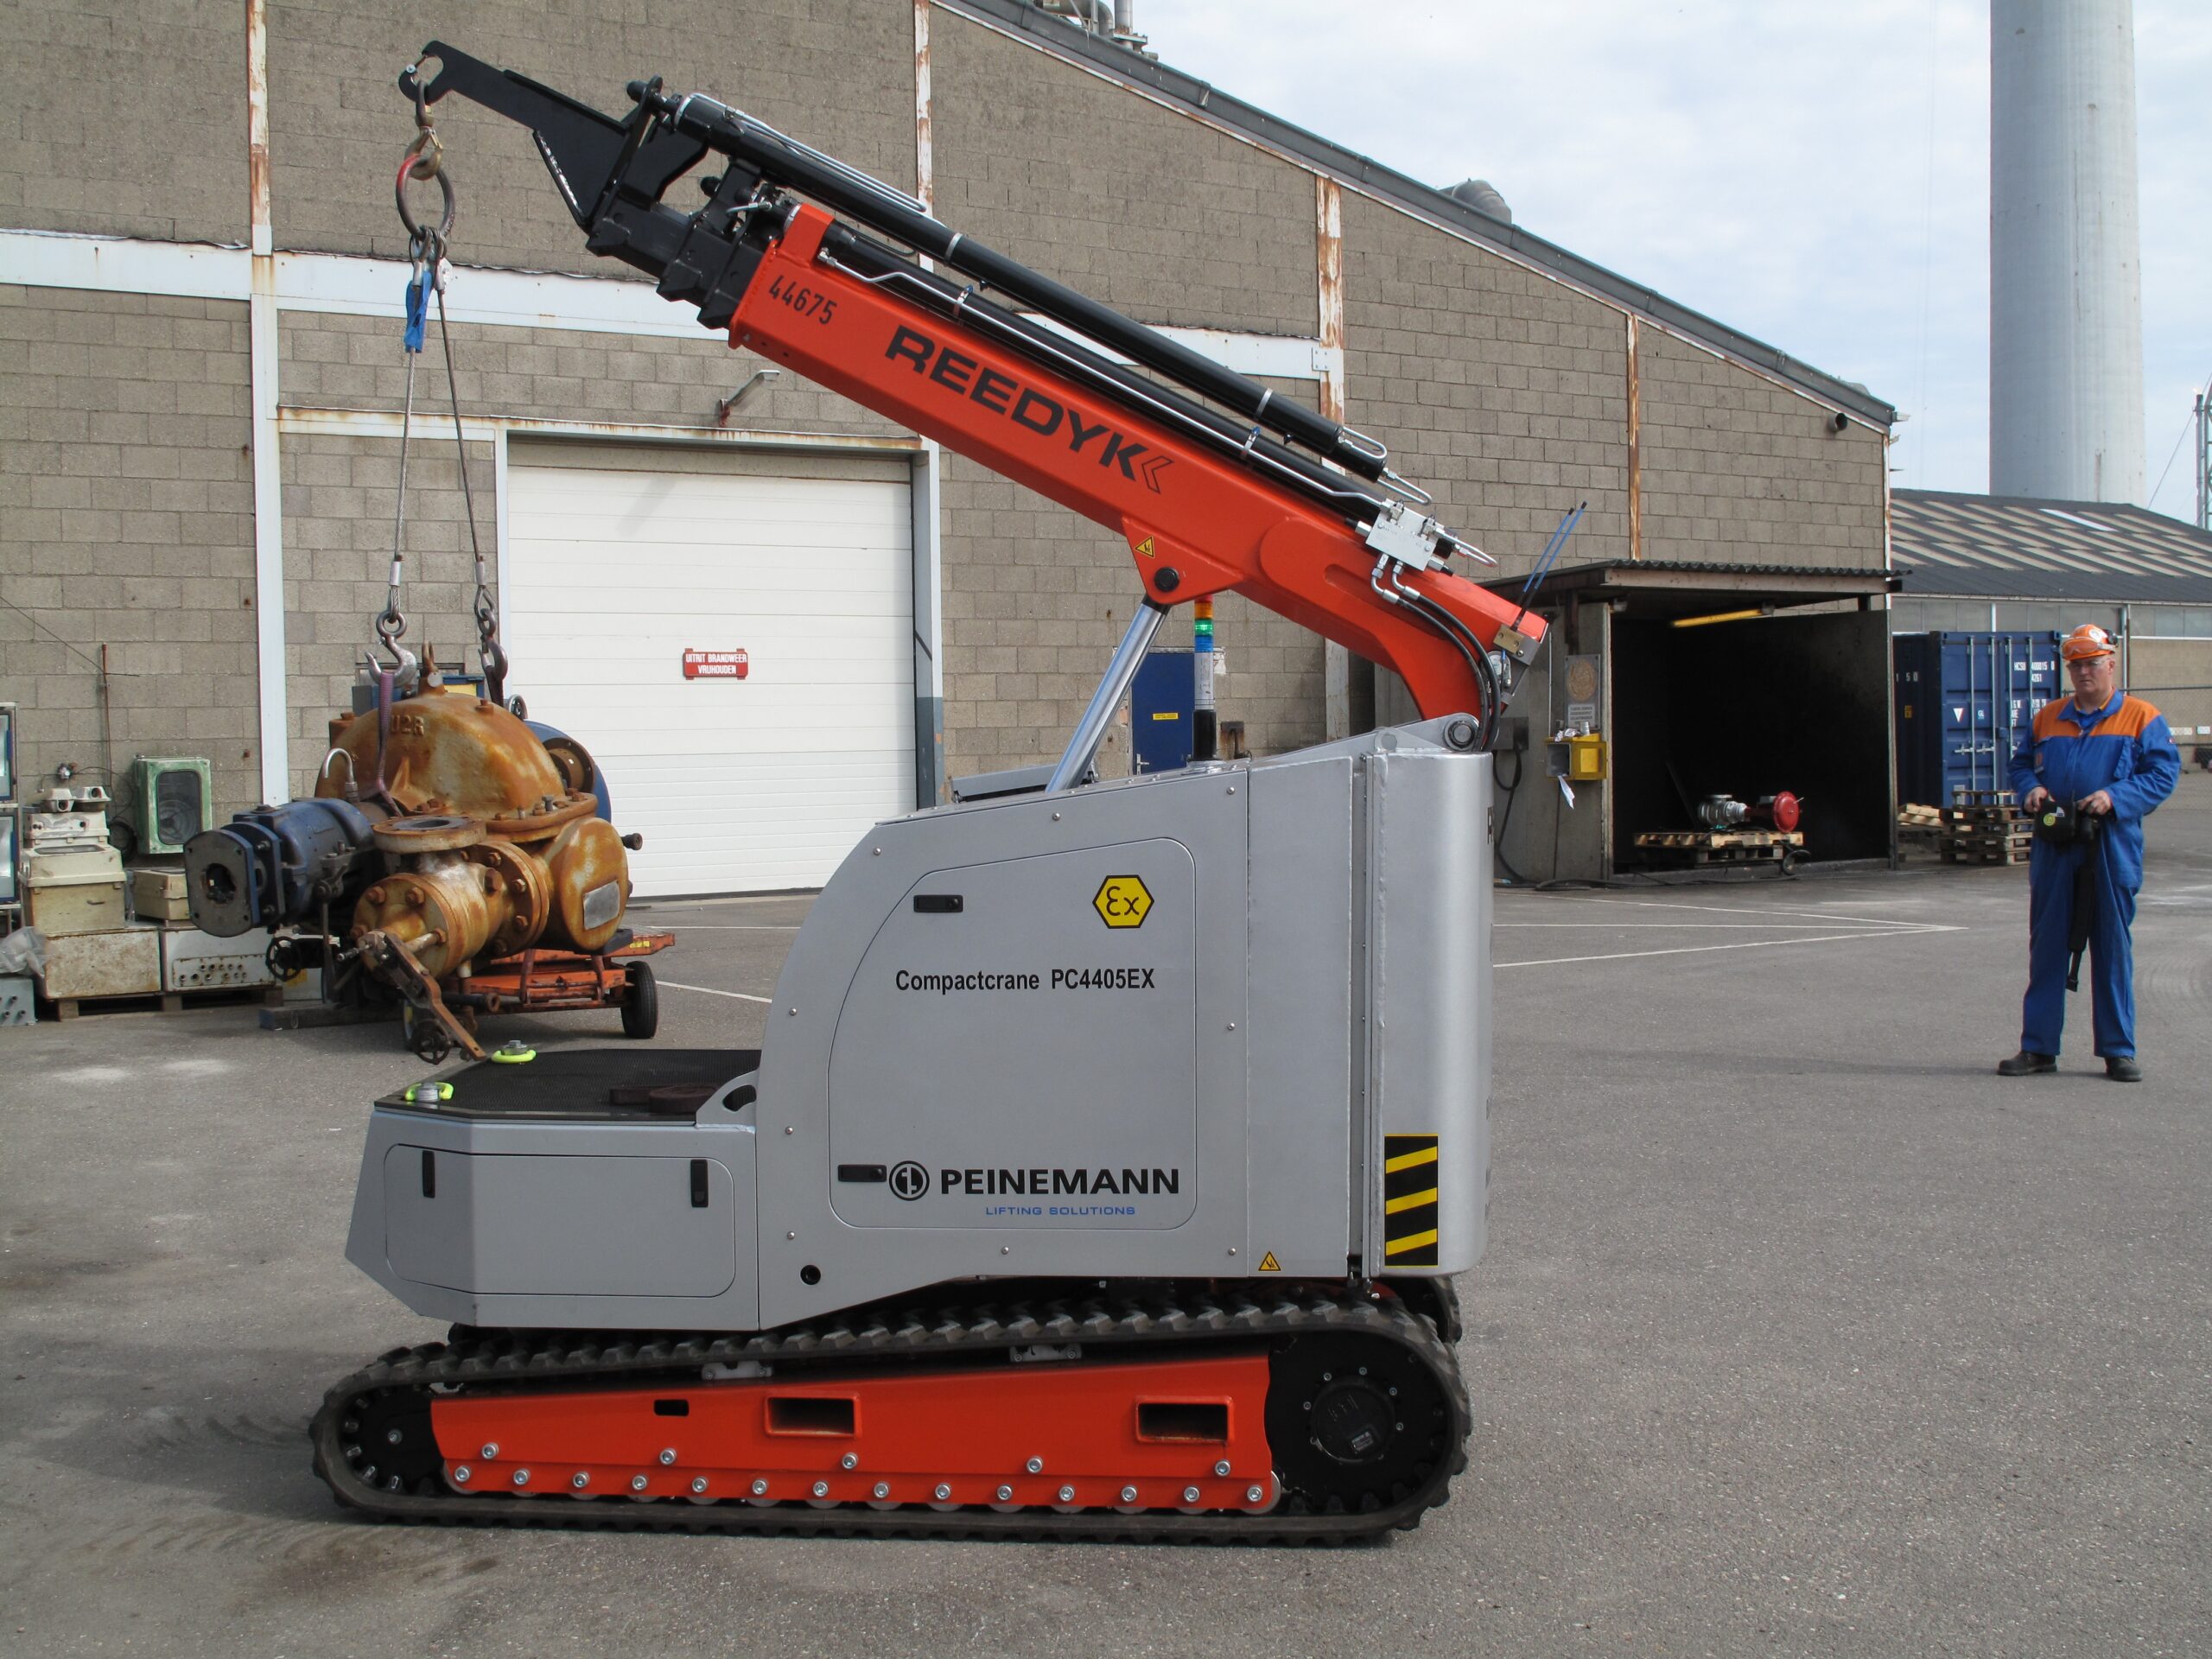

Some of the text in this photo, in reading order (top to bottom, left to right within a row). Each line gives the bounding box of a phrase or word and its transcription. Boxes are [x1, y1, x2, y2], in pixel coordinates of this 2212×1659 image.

[768, 275, 837, 326] 44675
[885, 326, 1150, 480] REEDYK
[686, 653, 747, 663] UITRIT BRANDWEER
[698, 664, 736, 673] VRIJHOUDEN
[895, 967, 1156, 995] Compactcrane PC4405EX
[940, 1168, 1180, 1195] PEINEMANN
[985, 1205, 1136, 1216] LIFTING SOLUTIONS
